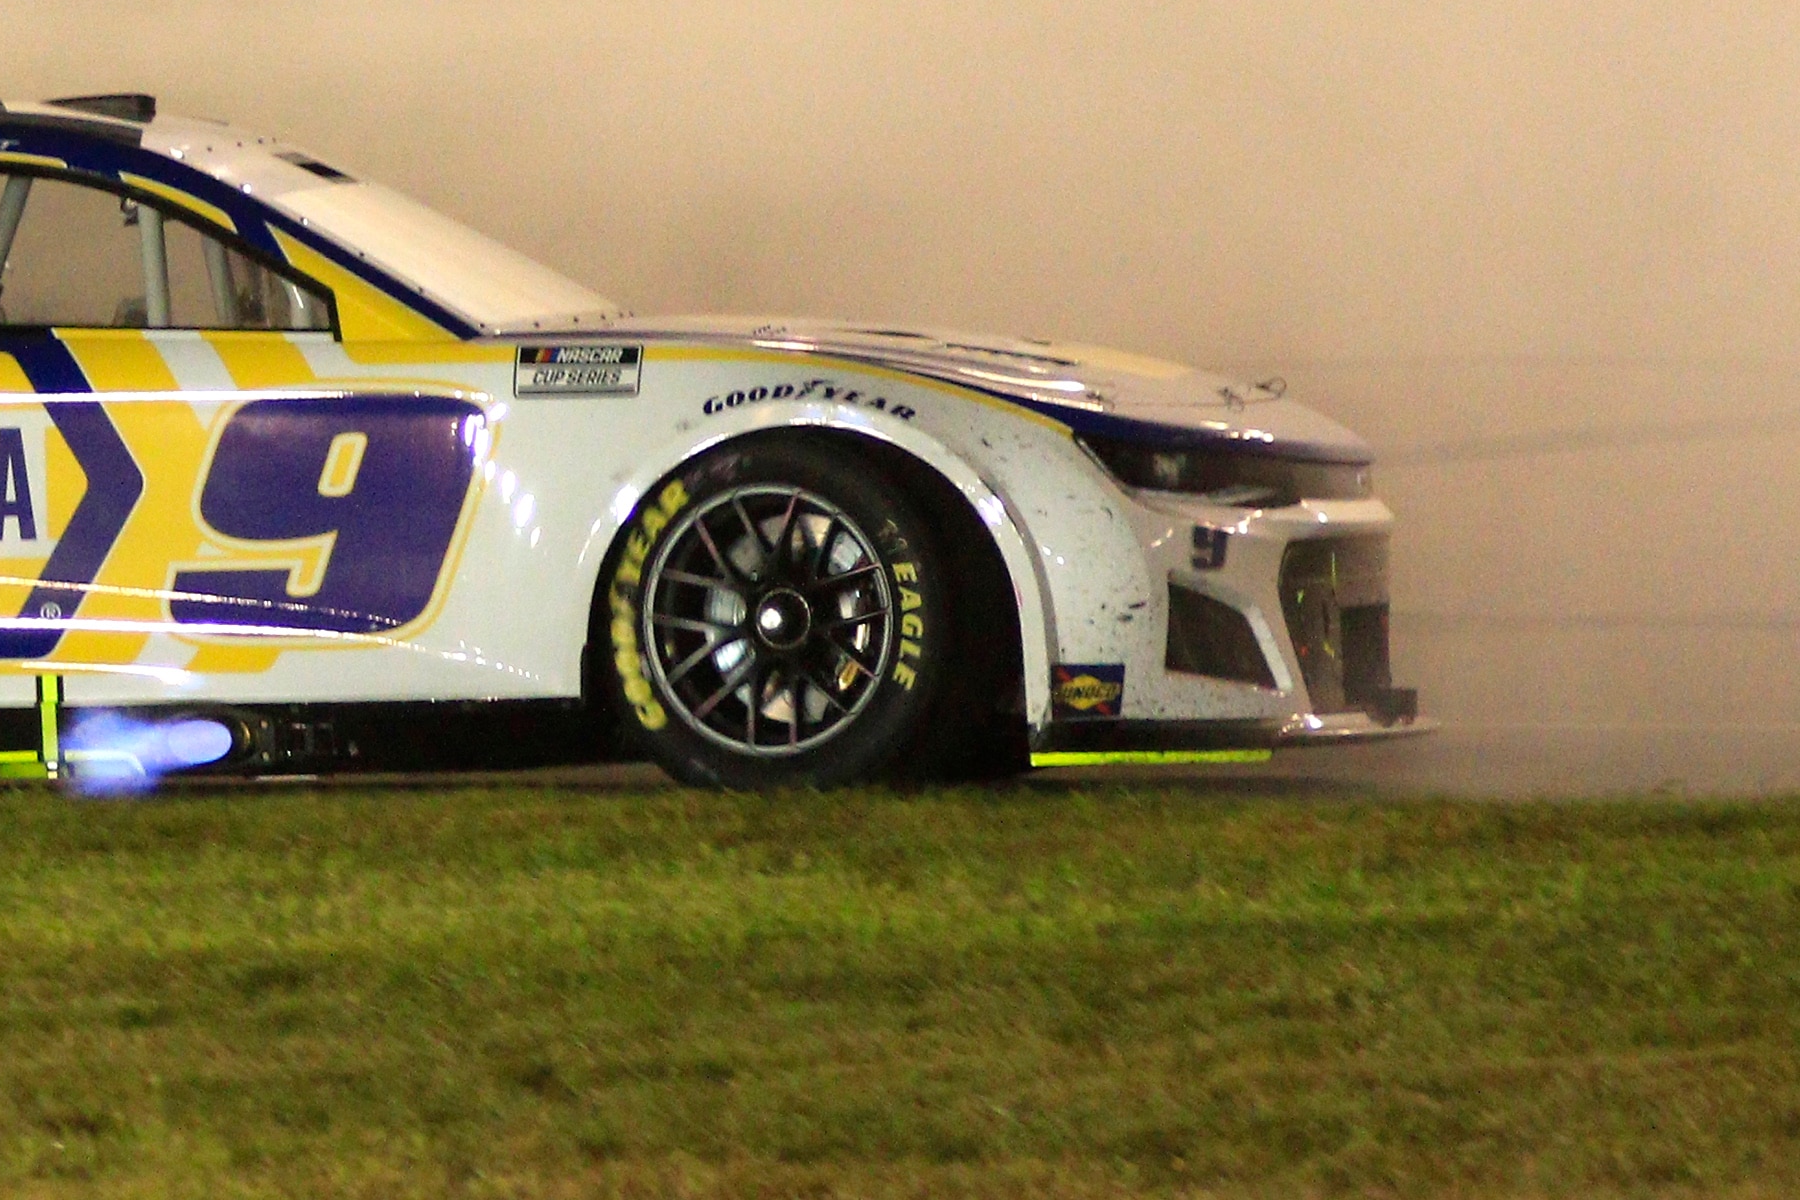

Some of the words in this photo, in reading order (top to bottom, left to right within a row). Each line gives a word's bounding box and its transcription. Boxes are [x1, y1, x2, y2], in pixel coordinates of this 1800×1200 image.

[533, 370, 566, 385] CUP
[564, 369, 622, 385] SERIES
[556, 347, 624, 364] NASCAR
[160, 381, 495, 643] 9
[891, 562, 925, 691] EAGLE
